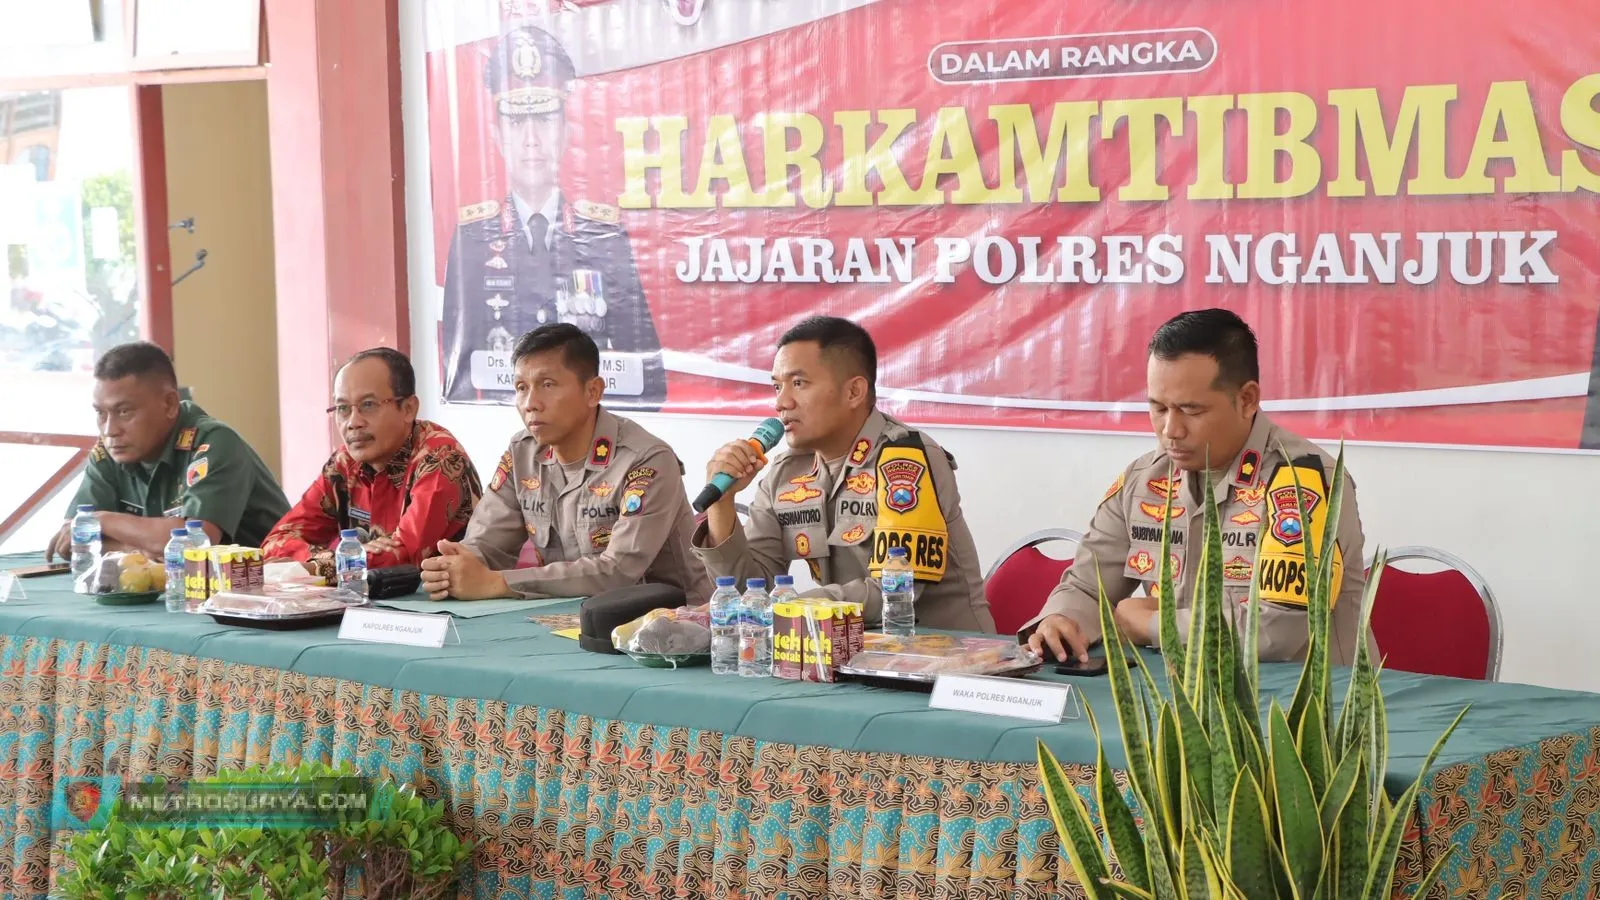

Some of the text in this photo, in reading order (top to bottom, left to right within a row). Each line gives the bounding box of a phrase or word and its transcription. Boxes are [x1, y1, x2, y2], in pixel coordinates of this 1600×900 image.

[940, 39, 1202, 75] DALAM RANGKA
[675, 230, 1560, 285] JAJARAN POLRES NGANJUK
[487, 356, 508, 368] Drs.
[602, 359, 626, 372] M.Si
[840, 500, 878, 517] POLRI
[1131, 525, 1183, 545] SUBIYANNA
[1221, 532, 1257, 547] POLR
[915, 534, 944, 569] RES
[362, 621, 424, 634] KAPOLRES NGANJUK
[774, 628, 801, 652] teh
[952, 688, 1044, 707] WAKA POLRES NGANJUK
